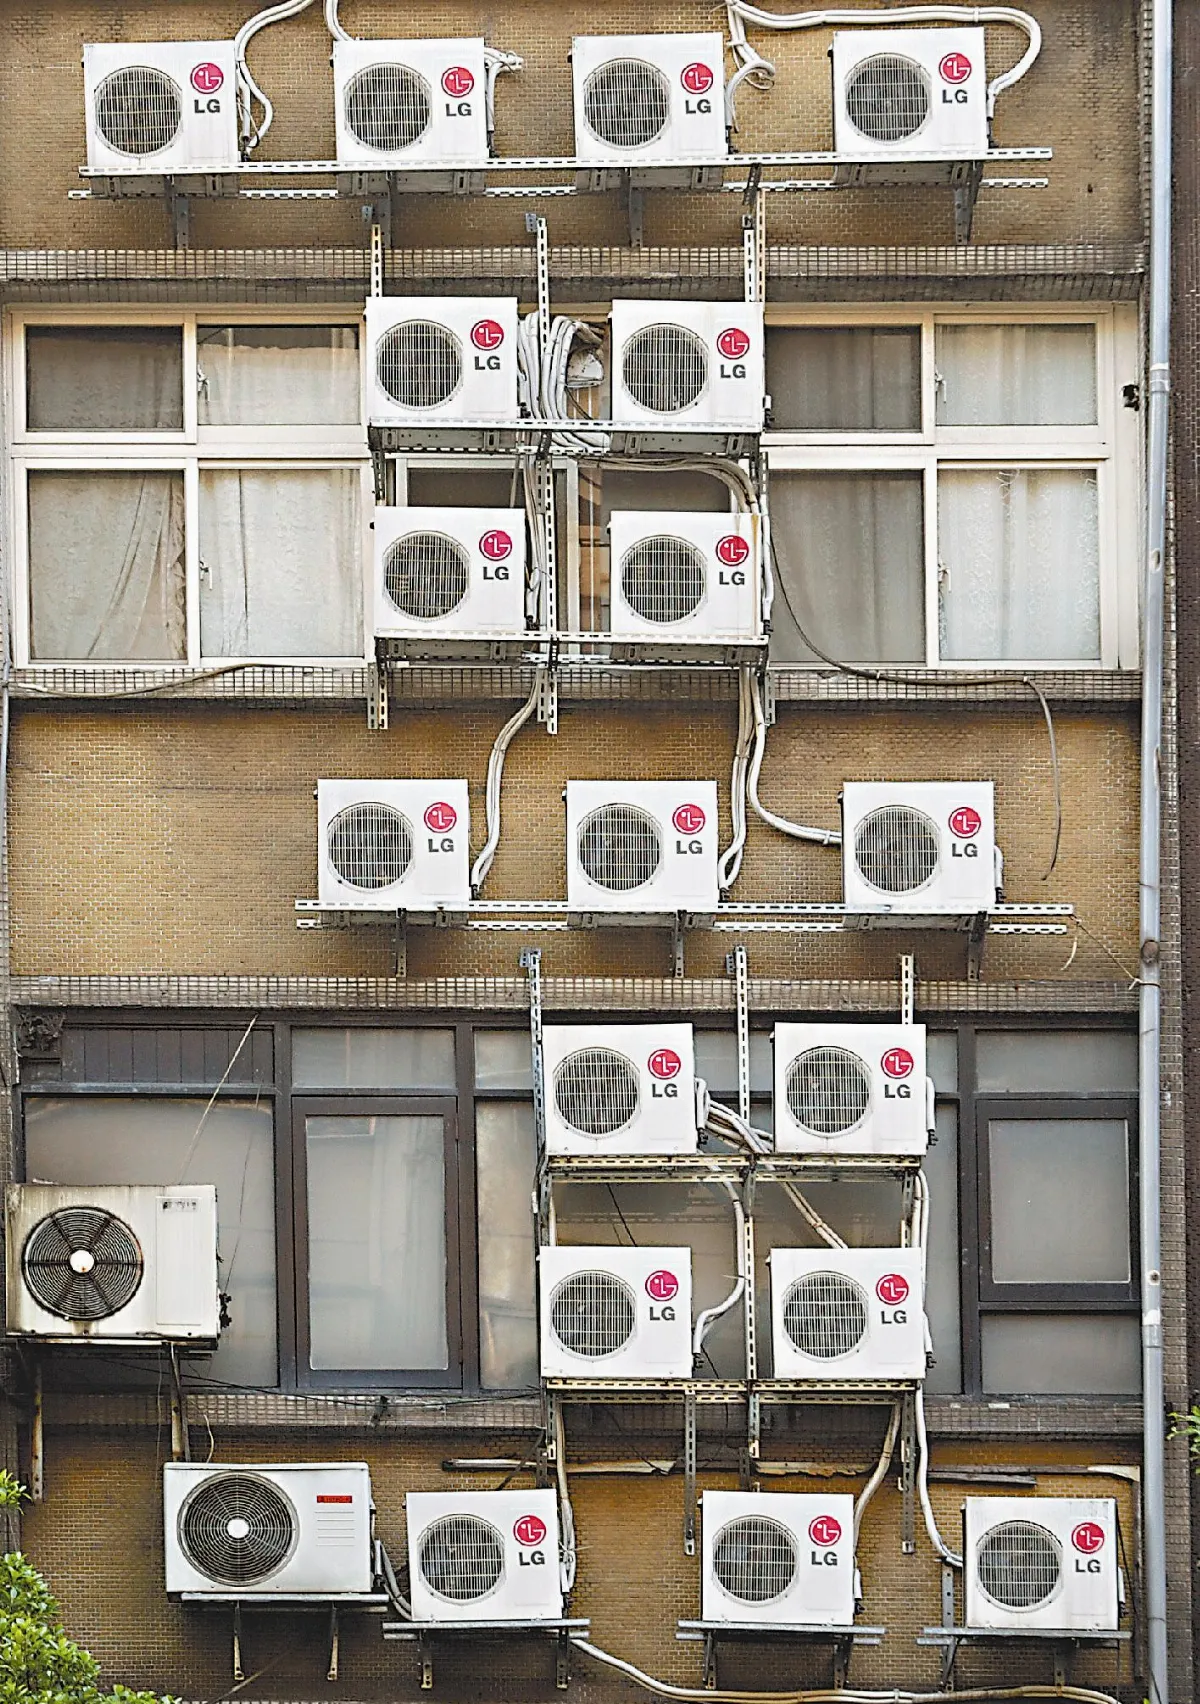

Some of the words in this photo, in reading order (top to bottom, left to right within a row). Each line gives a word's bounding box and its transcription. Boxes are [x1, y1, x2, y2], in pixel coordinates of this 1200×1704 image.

[943, 89, 967, 103] LG
[194, 99, 220, 113] LG
[446, 103, 471, 116] LG
[685, 99, 711, 114] LG
[475, 356, 500, 370] LG
[720, 364, 745, 378] LG
[483, 566, 509, 580] LG
[719, 571, 745, 585] LG
[428, 838, 454, 852] LG
[676, 840, 702, 854] LG
[952, 843, 977, 857] LG
[652, 1083, 677, 1097] LG
[885, 1084, 910, 1098] LG
[650, 1306, 675, 1321] LG
[881, 1310, 906, 1324] LG
[519, 1551, 545, 1566] LG
[811, 1551, 837, 1566] LG
[1076, 1559, 1100, 1573] LG
